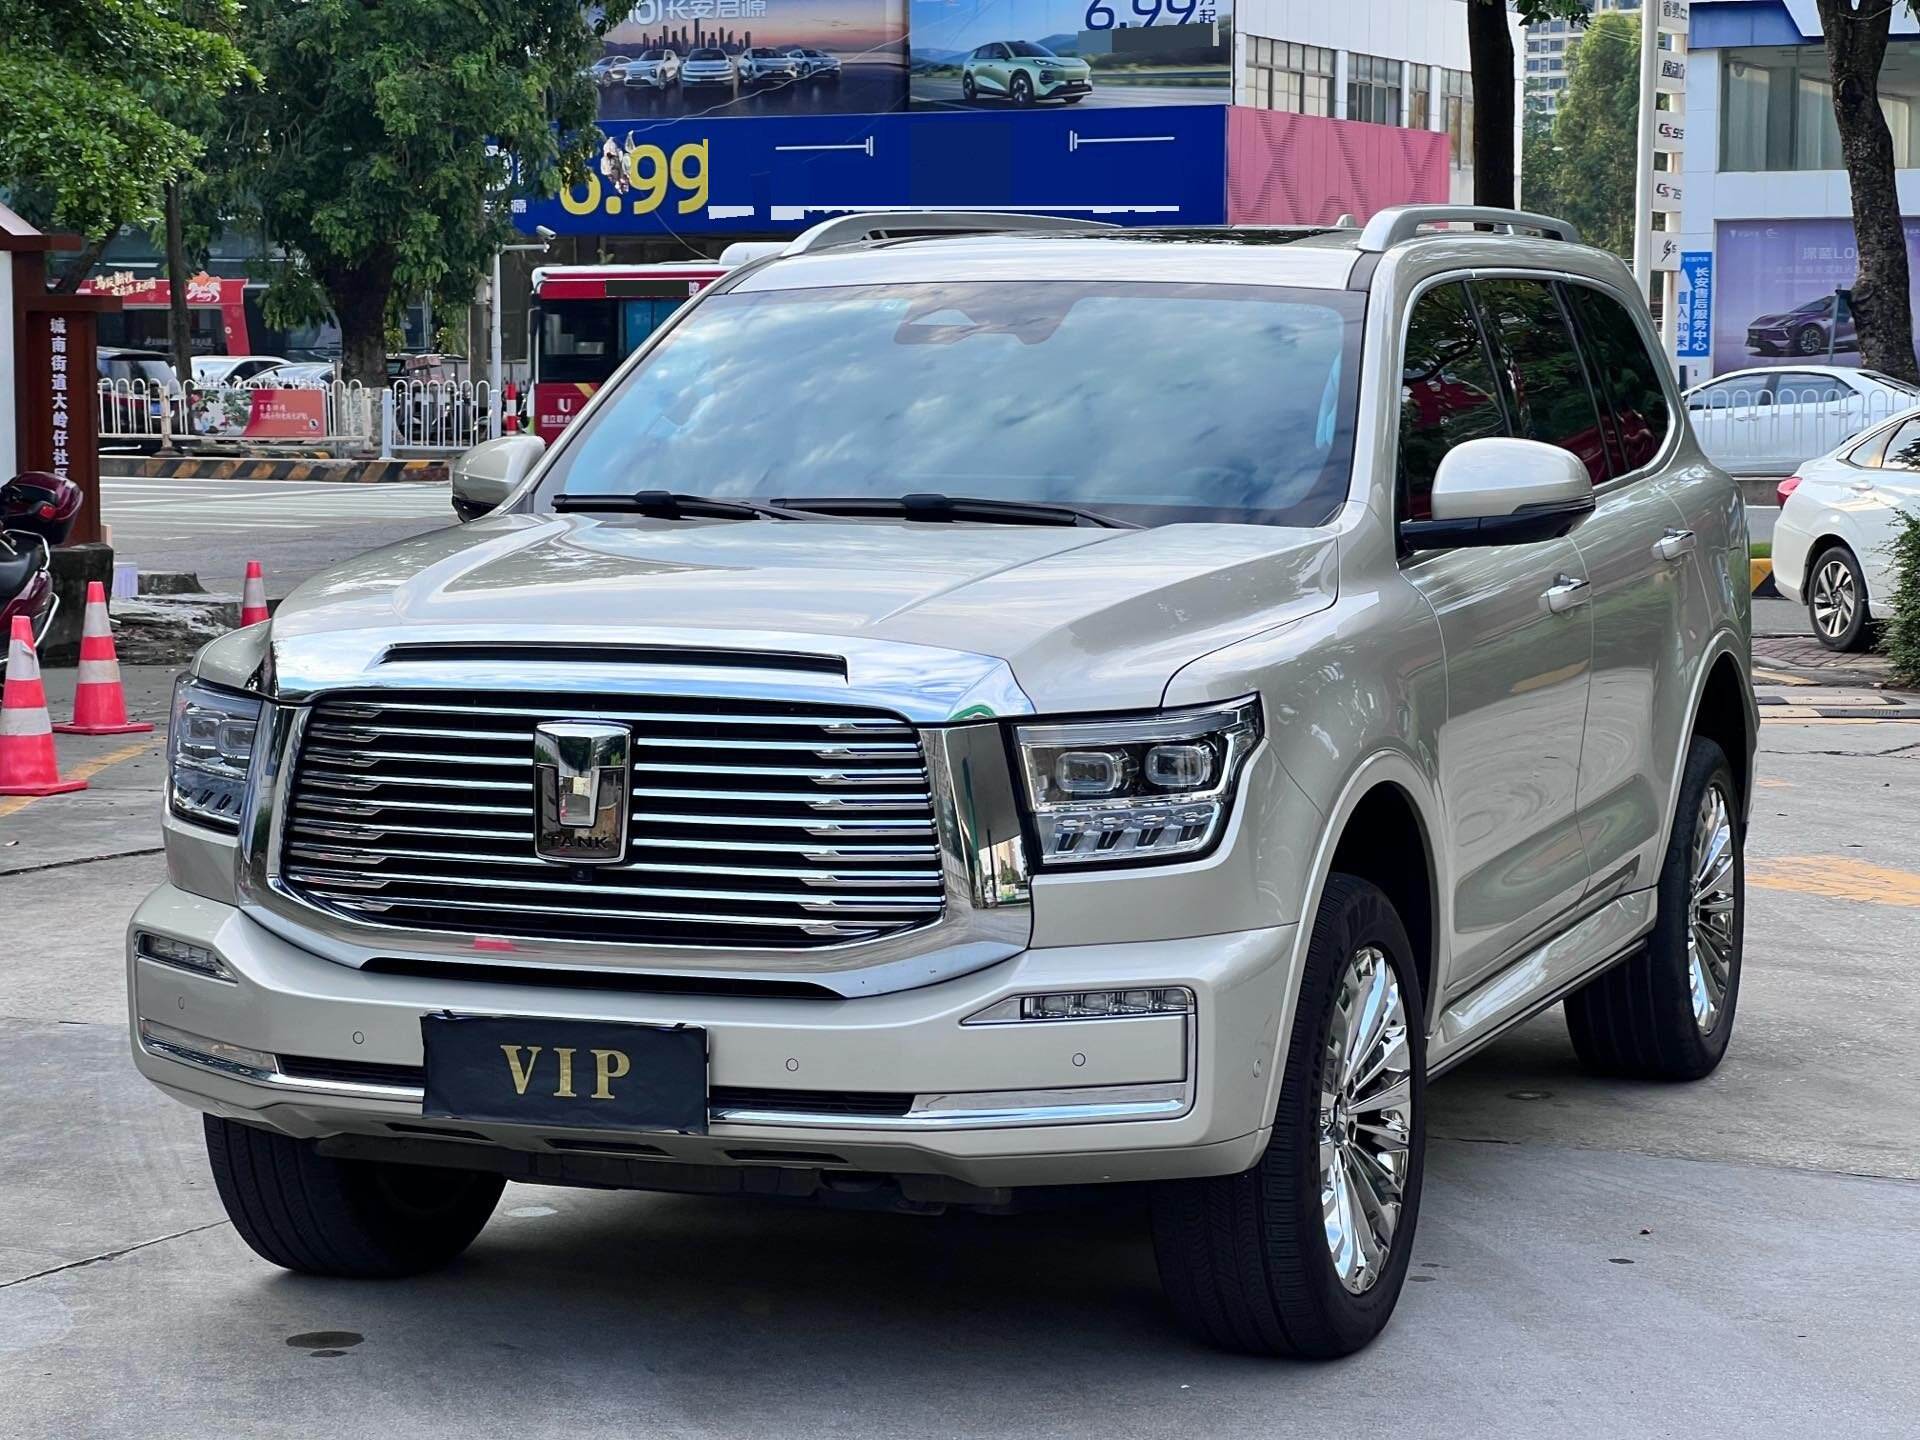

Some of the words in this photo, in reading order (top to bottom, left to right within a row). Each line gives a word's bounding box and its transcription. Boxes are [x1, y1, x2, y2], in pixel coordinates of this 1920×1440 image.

[666, 0, 768, 19] 长安启源
[547, 834, 608, 849] TANK
[501, 1045, 630, 1099] VIP
